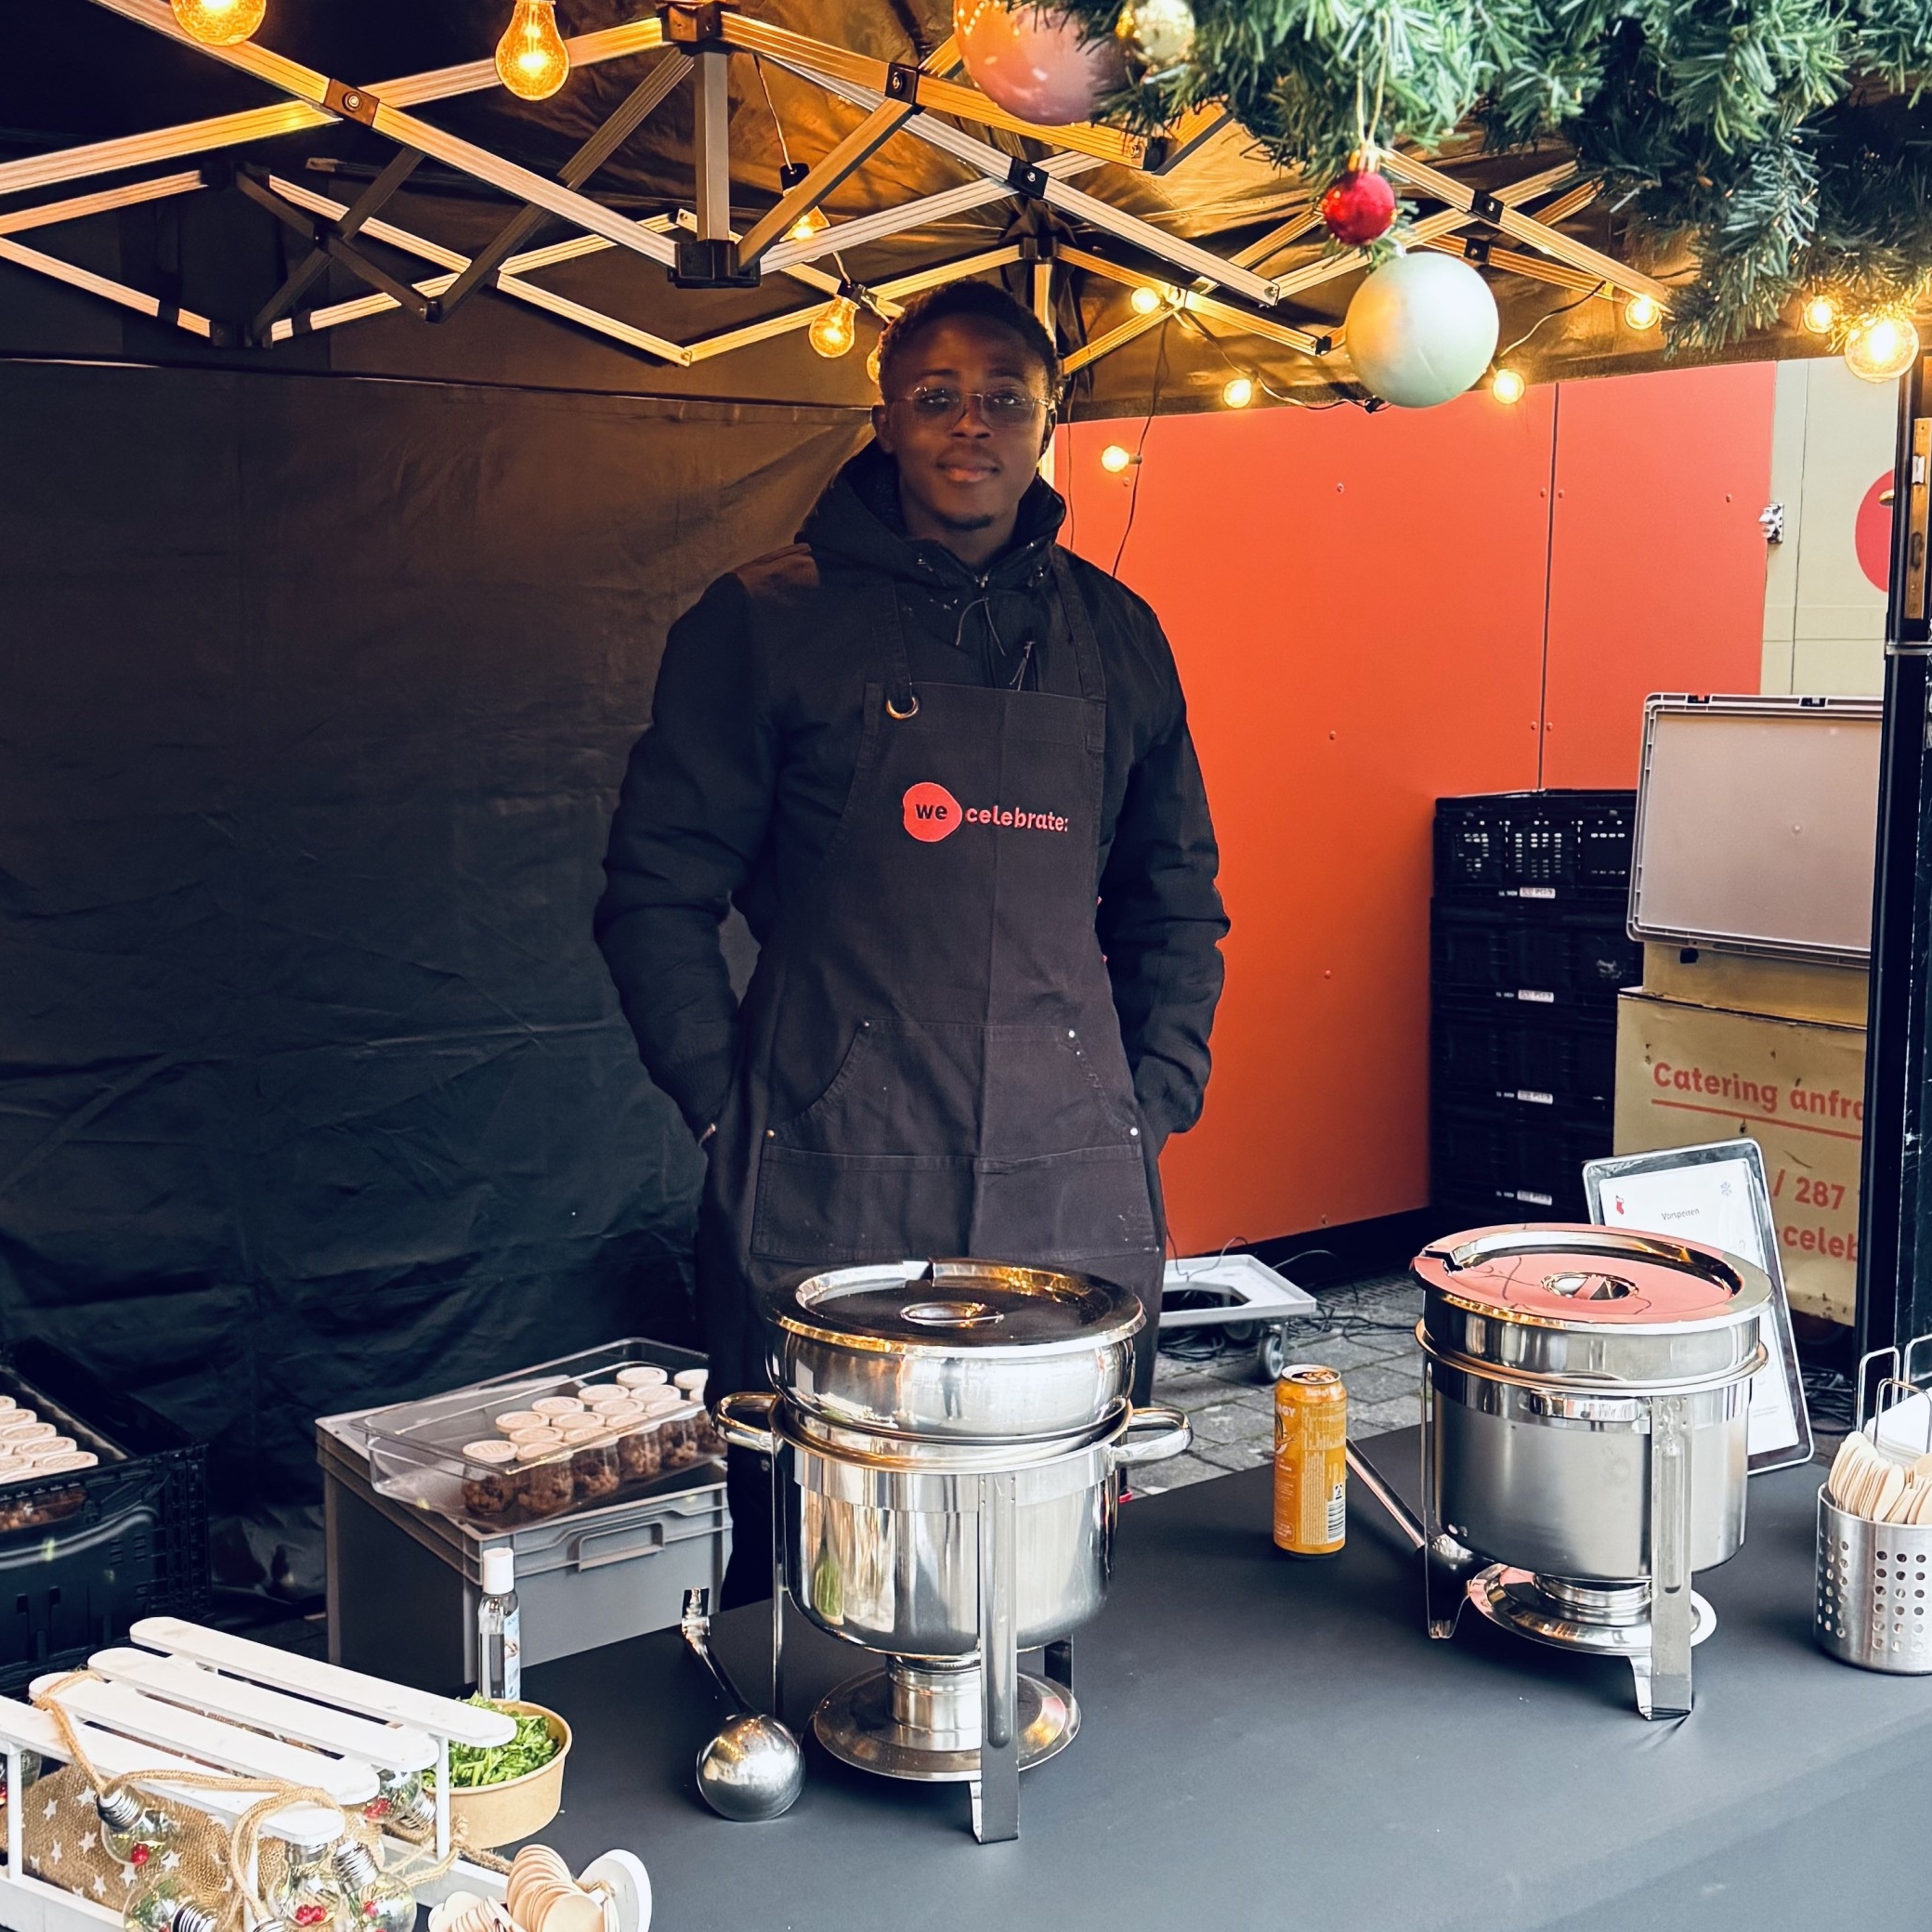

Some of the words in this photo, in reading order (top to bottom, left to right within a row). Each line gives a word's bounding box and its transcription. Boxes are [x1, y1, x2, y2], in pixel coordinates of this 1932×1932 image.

[915, 803, 948, 820] we
[1653, 1062, 1778, 1114] Catering
[1795, 1176, 1847, 1210] 287
